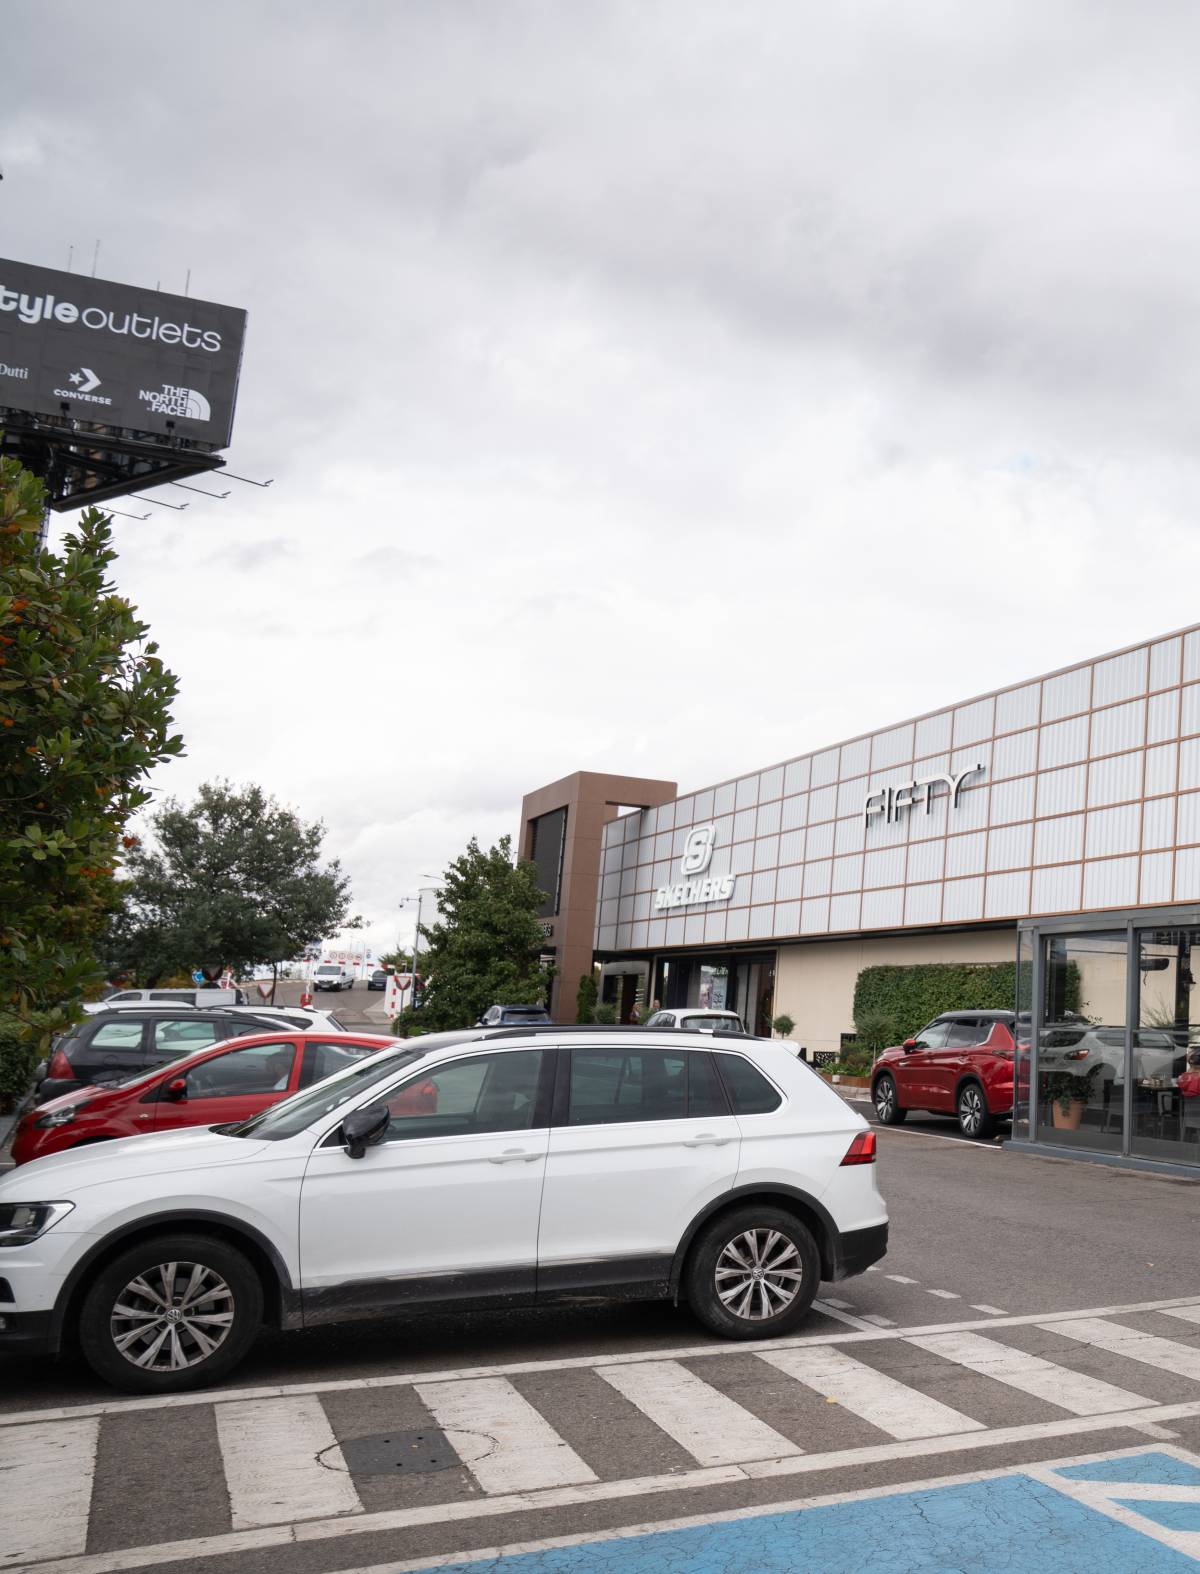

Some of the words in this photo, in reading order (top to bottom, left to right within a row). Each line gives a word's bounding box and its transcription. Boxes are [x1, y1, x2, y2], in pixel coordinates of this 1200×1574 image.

[0, 363, 28, 379] Dutti
[53, 388, 113, 405] CONVERSE
[139, 389, 188, 408] NORTH
[162, 384, 189, 398] THE
[151, 402, 187, 418] FACE
[863, 763, 986, 829] FIFTY
[654, 872, 736, 911] SKECHERS
